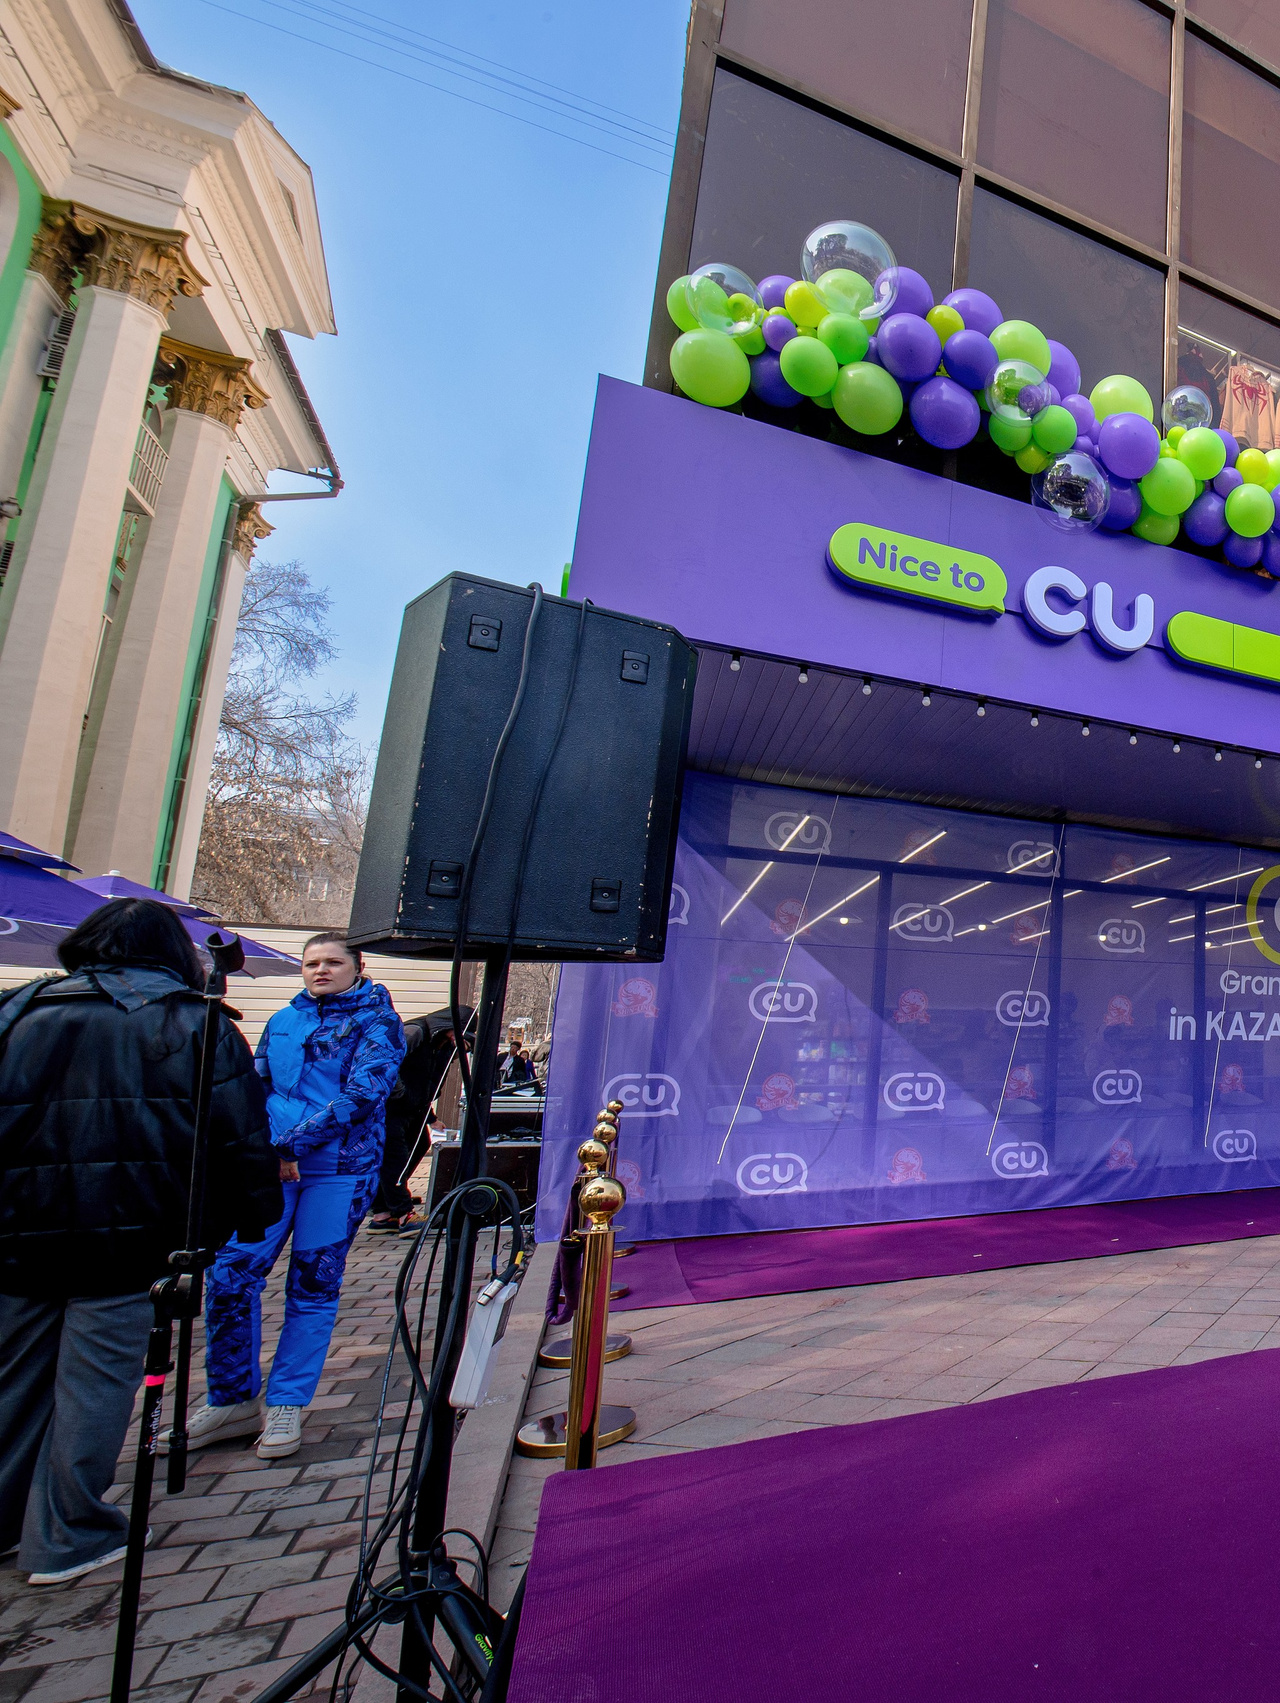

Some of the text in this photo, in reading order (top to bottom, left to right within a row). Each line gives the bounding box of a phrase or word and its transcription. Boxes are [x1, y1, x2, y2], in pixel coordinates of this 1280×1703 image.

[857, 537, 1155, 652] Nice to CU
[906, 911, 942, 932] CU
[1105, 927, 1136, 944] CU
[762, 991, 804, 1013] CU
[1007, 998, 1040, 1017] CU
[1169, 1008, 1196, 1041] in
[618, 1085, 665, 1106] CU
[896, 1082, 933, 1101] CU
[1102, 1079, 1133, 1095] CU
[1222, 1138, 1248, 1154] CU
[1003, 1151, 1036, 1169] CU
[751, 1164, 793, 1184] CU
